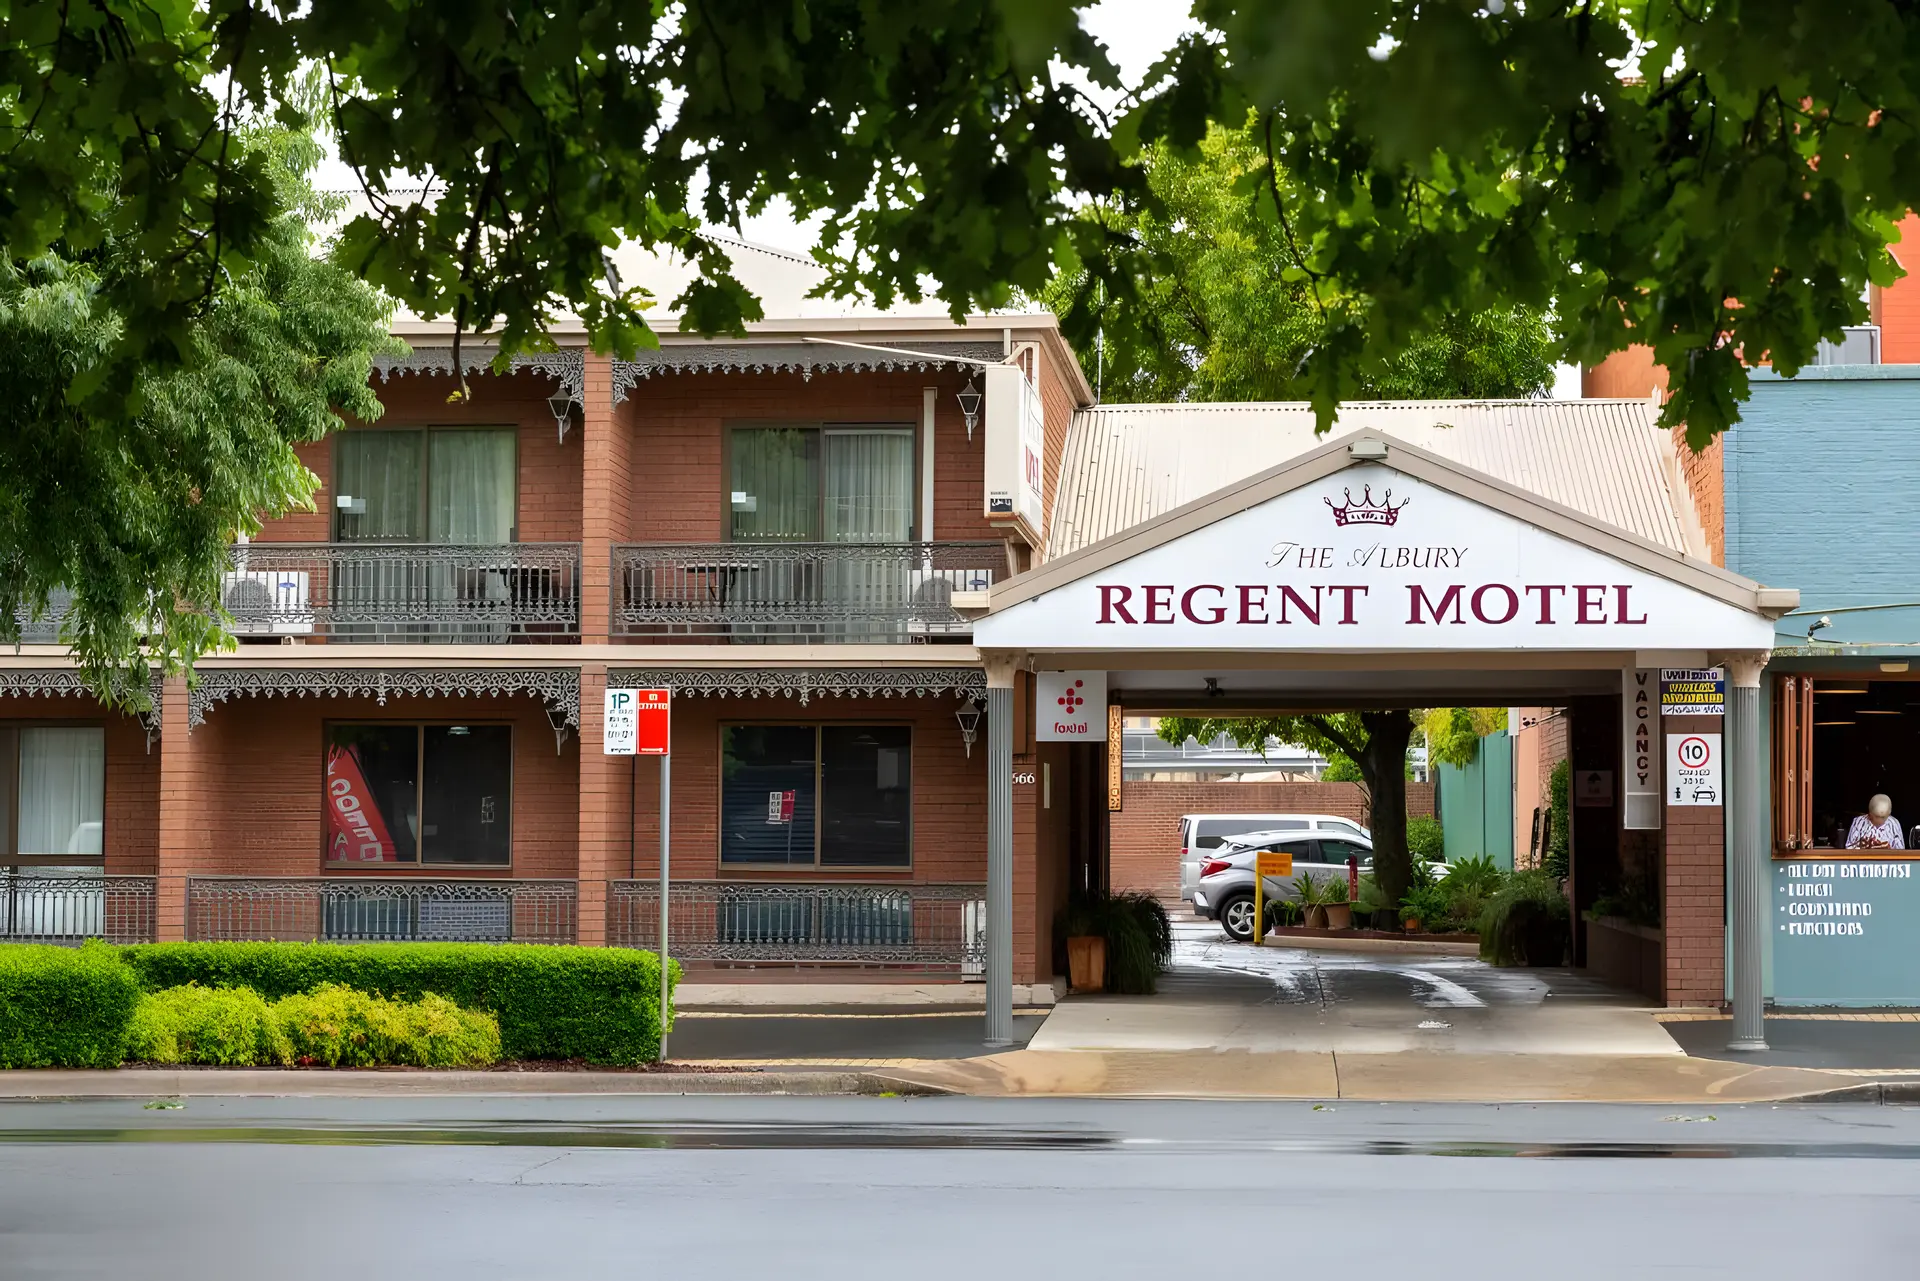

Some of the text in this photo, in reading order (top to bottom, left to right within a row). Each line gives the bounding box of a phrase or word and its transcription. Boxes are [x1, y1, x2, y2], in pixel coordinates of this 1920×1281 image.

[1264, 541, 1469, 569] THE ALBURY
[1095, 583, 1648, 626] REGENT MOTEL
[611, 692, 631, 710] 1P
[1635, 672, 1649, 786] VACANCY
[1684, 745, 1704, 761] 10
